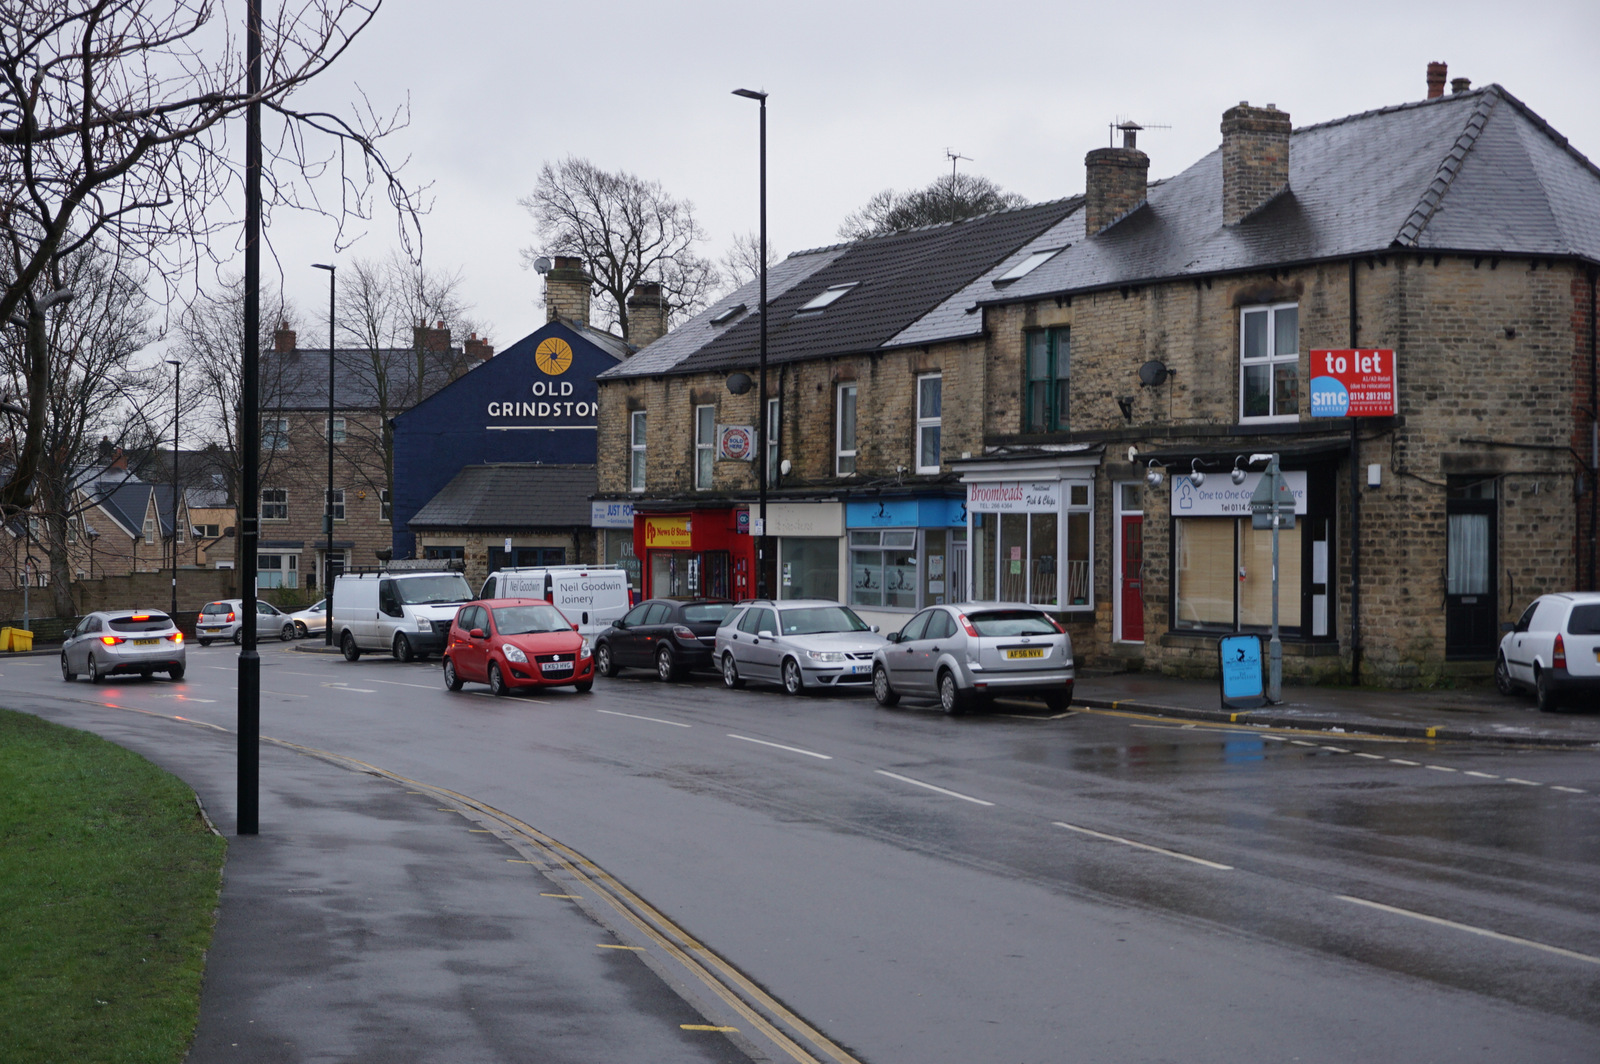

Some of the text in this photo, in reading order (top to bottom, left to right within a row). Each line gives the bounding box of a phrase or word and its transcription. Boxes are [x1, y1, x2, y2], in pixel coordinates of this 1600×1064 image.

[1325, 351, 1382, 373] to let
[532, 381, 573, 396] OLD
[1312, 391, 1347, 406] smc
[1350, 392, 1365, 400] 0114
[487, 402, 598, 417] GRINDSTON
[971, 481, 1023, 502] Broomheads
[1199, 490, 1214, 500] One
[1215, 491, 1223, 499] to
[1224, 489, 1239, 499] One
[1026, 495, 1036, 507] Fish
[1043, 494, 1056, 508] Chips
[607, 504, 620, 516] JUST
[657, 528, 670, 536] News
[510, 581, 540, 592] Neil Goodwin
[560, 582, 621, 592] Neil Goodwin
[561, 595, 594, 605] Joinery
